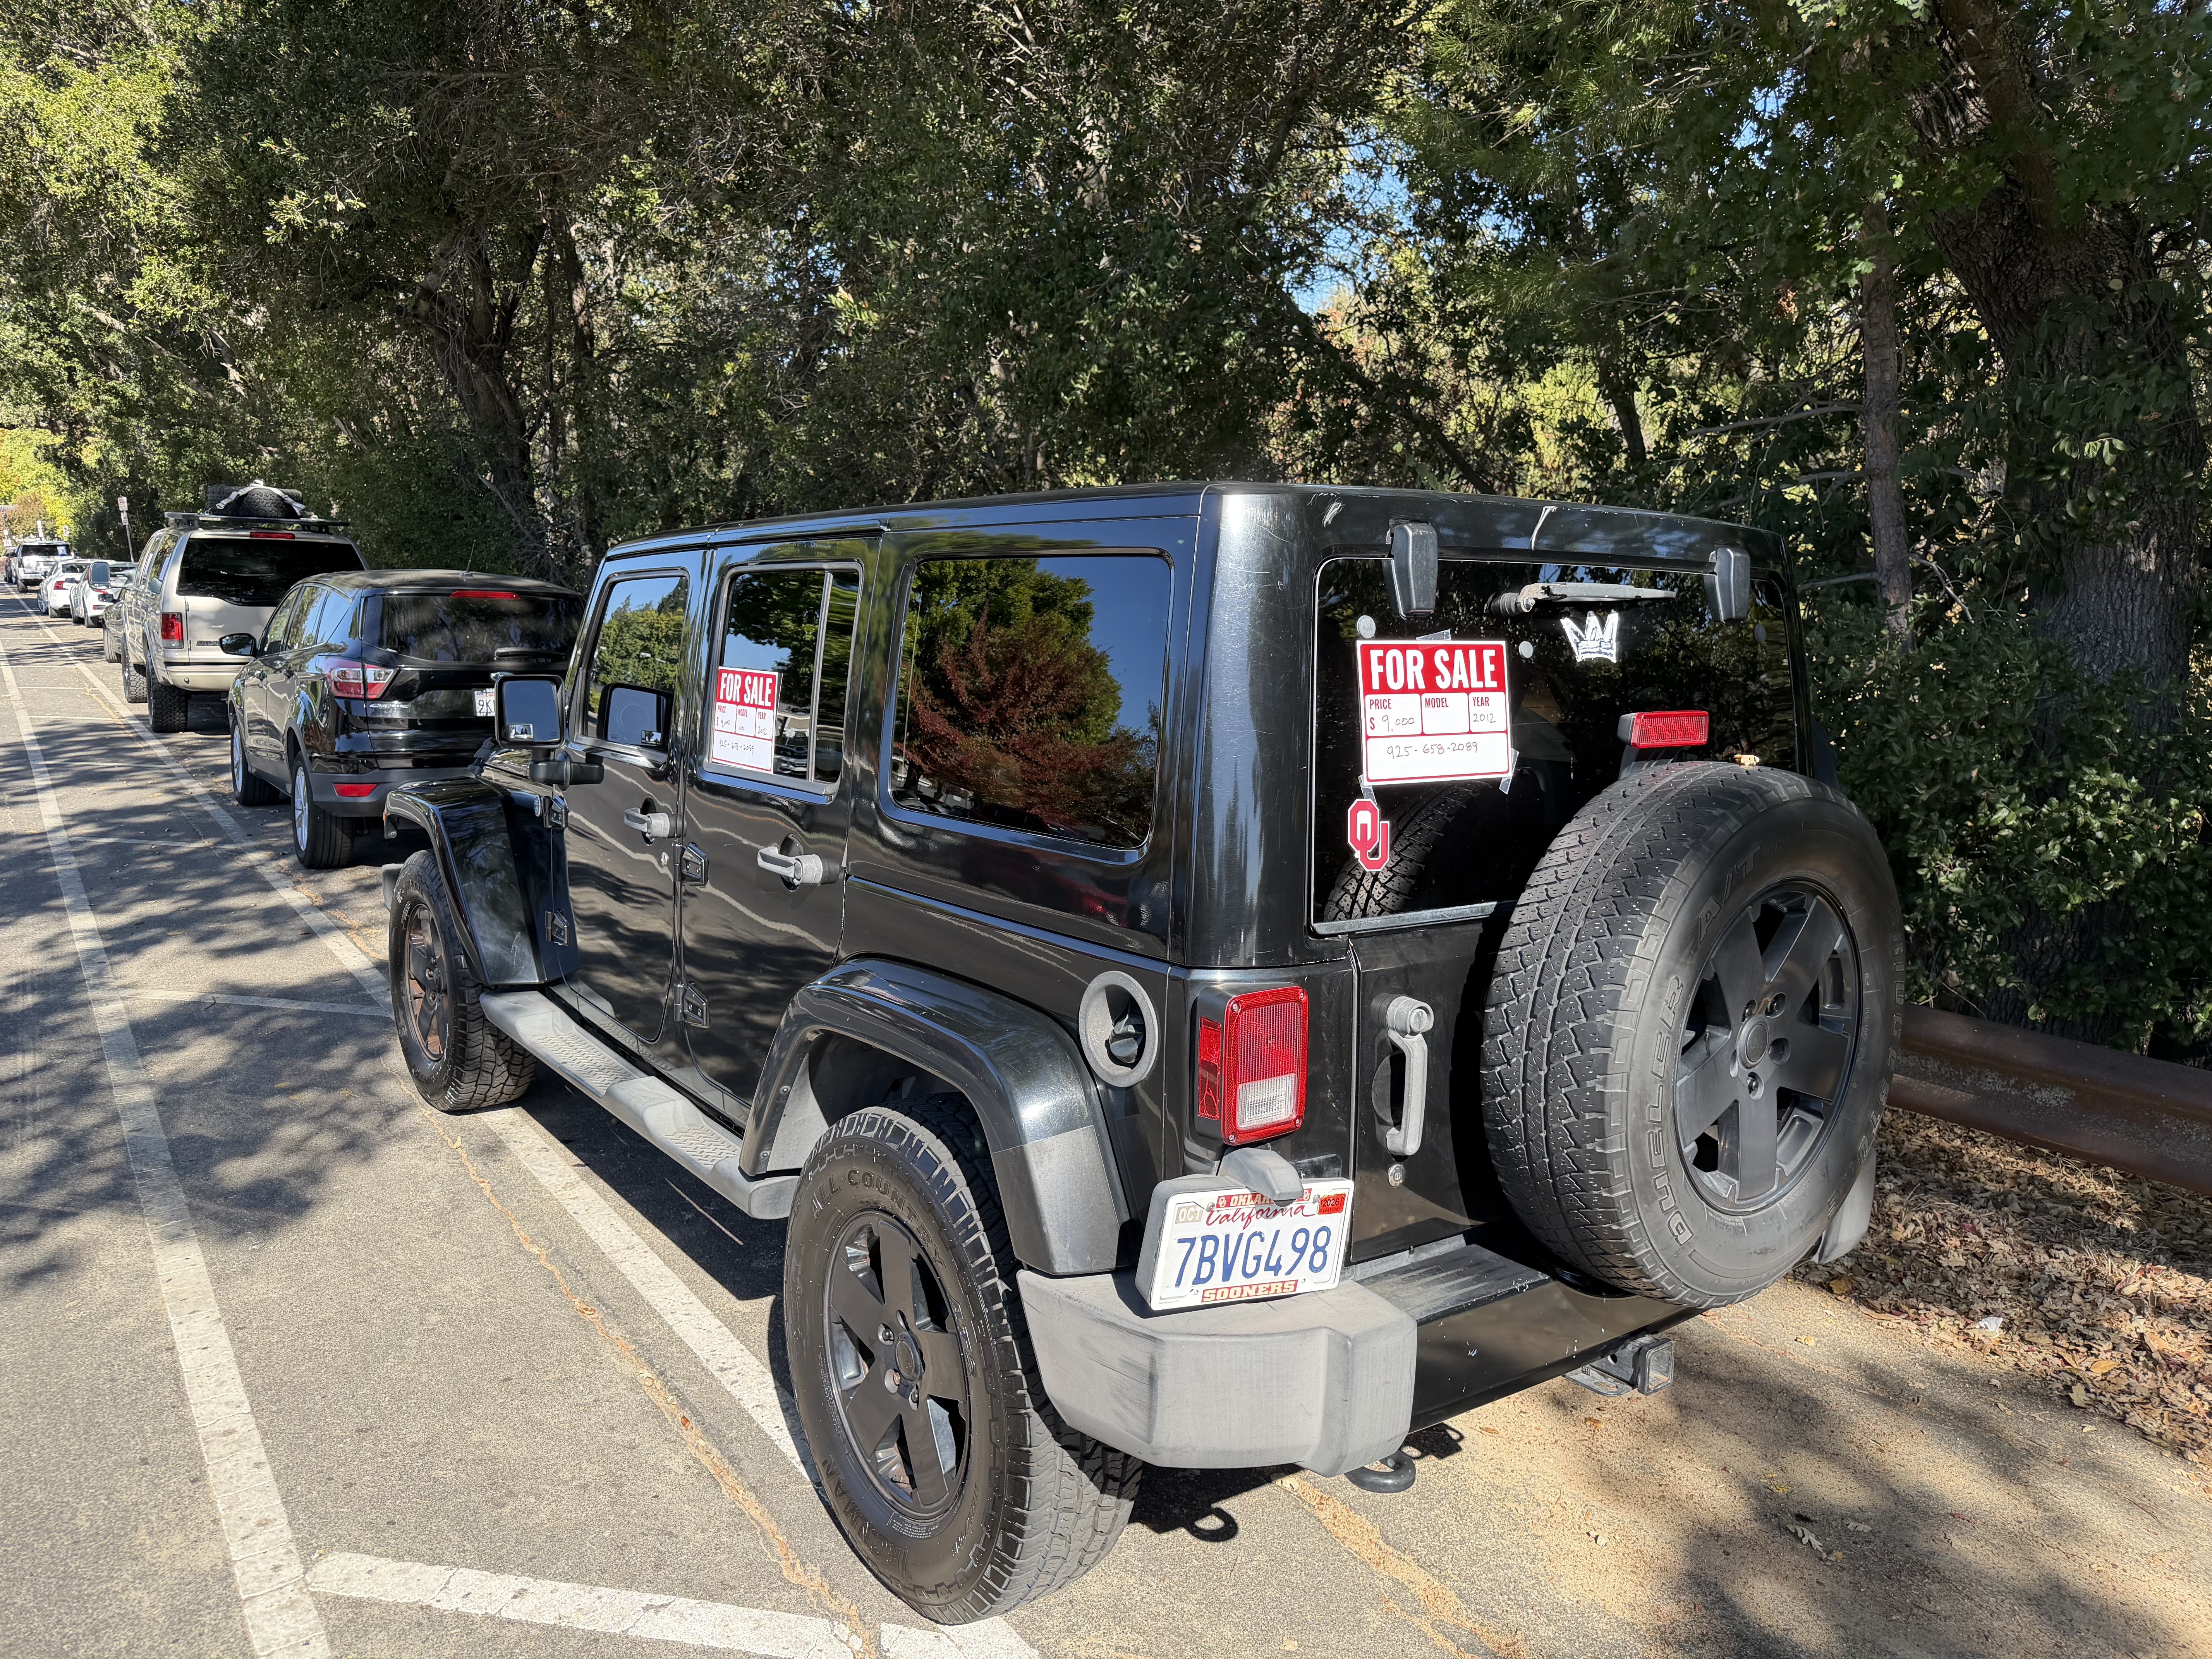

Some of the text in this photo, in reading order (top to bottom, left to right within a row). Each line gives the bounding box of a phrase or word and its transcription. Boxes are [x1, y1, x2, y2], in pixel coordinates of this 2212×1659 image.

[1370, 649, 1497, 690] FOR SALE
[720, 672, 772, 707] FOR SALE
[478, 699, 495, 713] 9K
[1369, 696, 1490, 709] PRICE MODEL YEAR
[1369, 717, 1375, 730] $
[1473, 713, 1497, 723] 2012
[1348, 799, 1389, 871] OU
[1647, 975, 1694, 1247] DUELER
[1230, 1193, 1274, 1207] OKLAH
[1322, 1197, 1340, 1207] 2026
[811, 1175, 841, 1223] ALL
[848, 1167, 946, 1268] COUNTRY
[1178, 1207, 1202, 1223] OCT
[1206, 1204, 1316, 1230] California
[1175, 1226, 1331, 1288] 7BVG498
[1203, 1281, 1297, 1303] SOONERS
